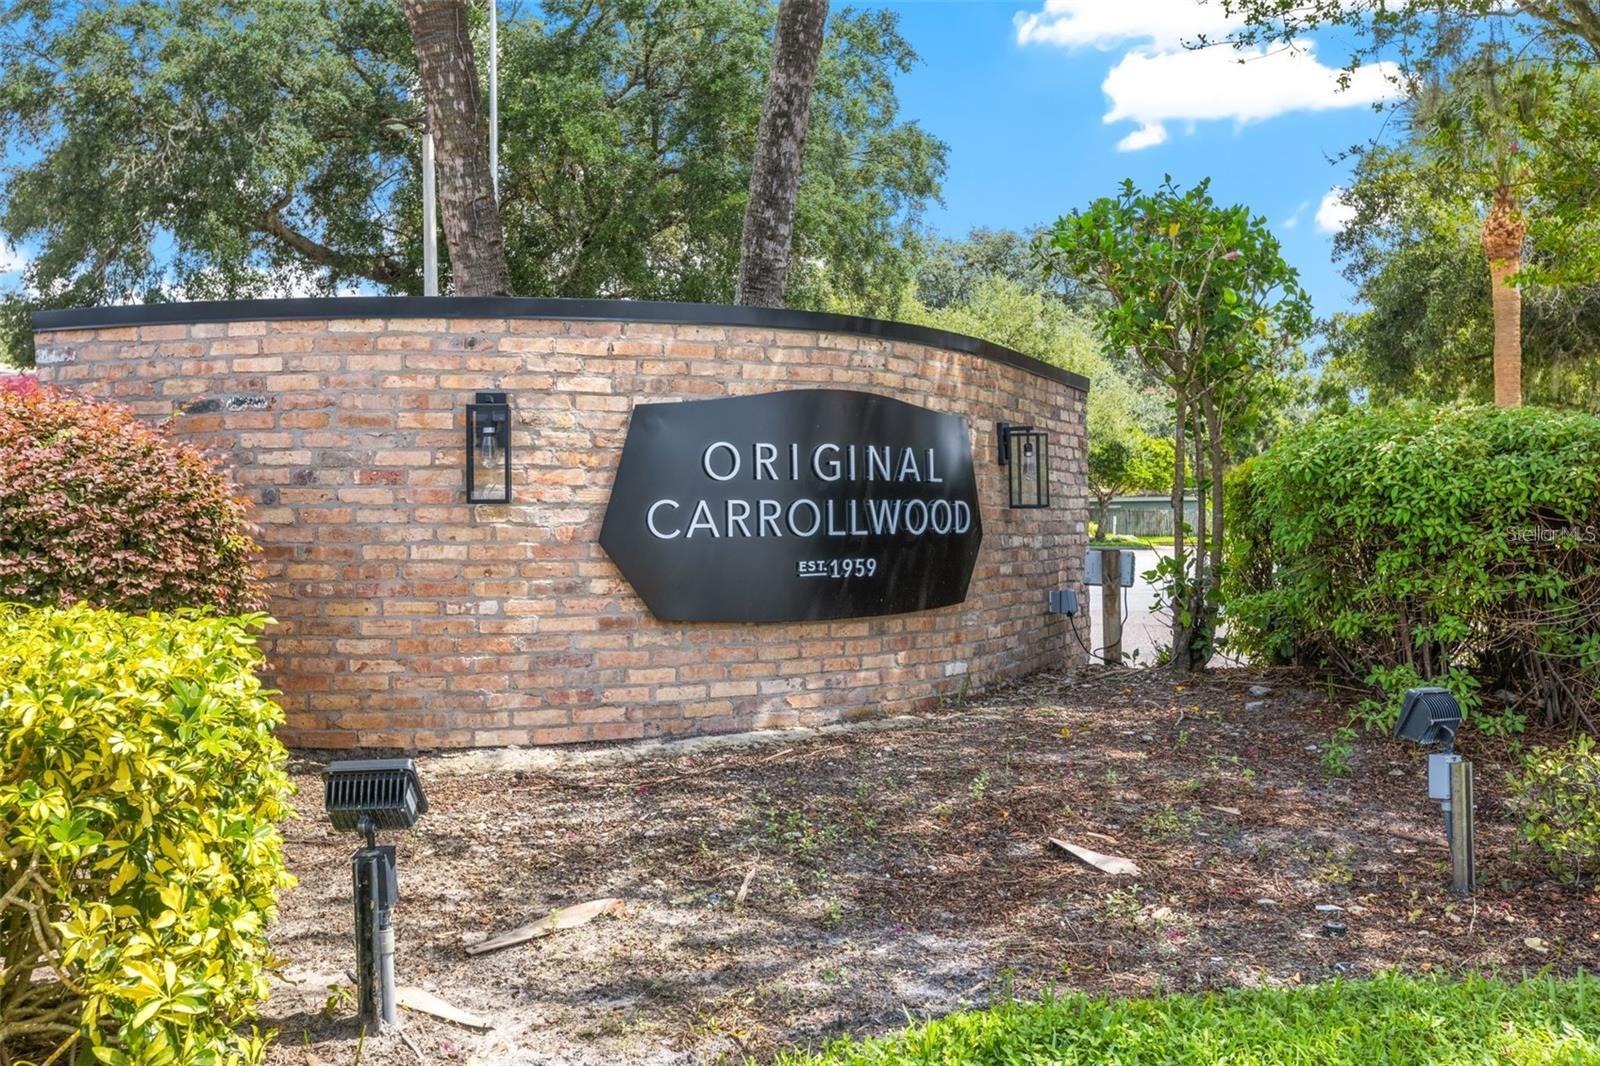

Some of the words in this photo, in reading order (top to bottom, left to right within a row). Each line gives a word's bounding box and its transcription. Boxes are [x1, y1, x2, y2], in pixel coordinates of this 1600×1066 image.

[703, 441, 944, 483] ORIGINAL
[646, 498, 971, 540] CARROLLWOOD
[798, 560, 828, 575] EST.
[830, 558, 877, 578] 1959
